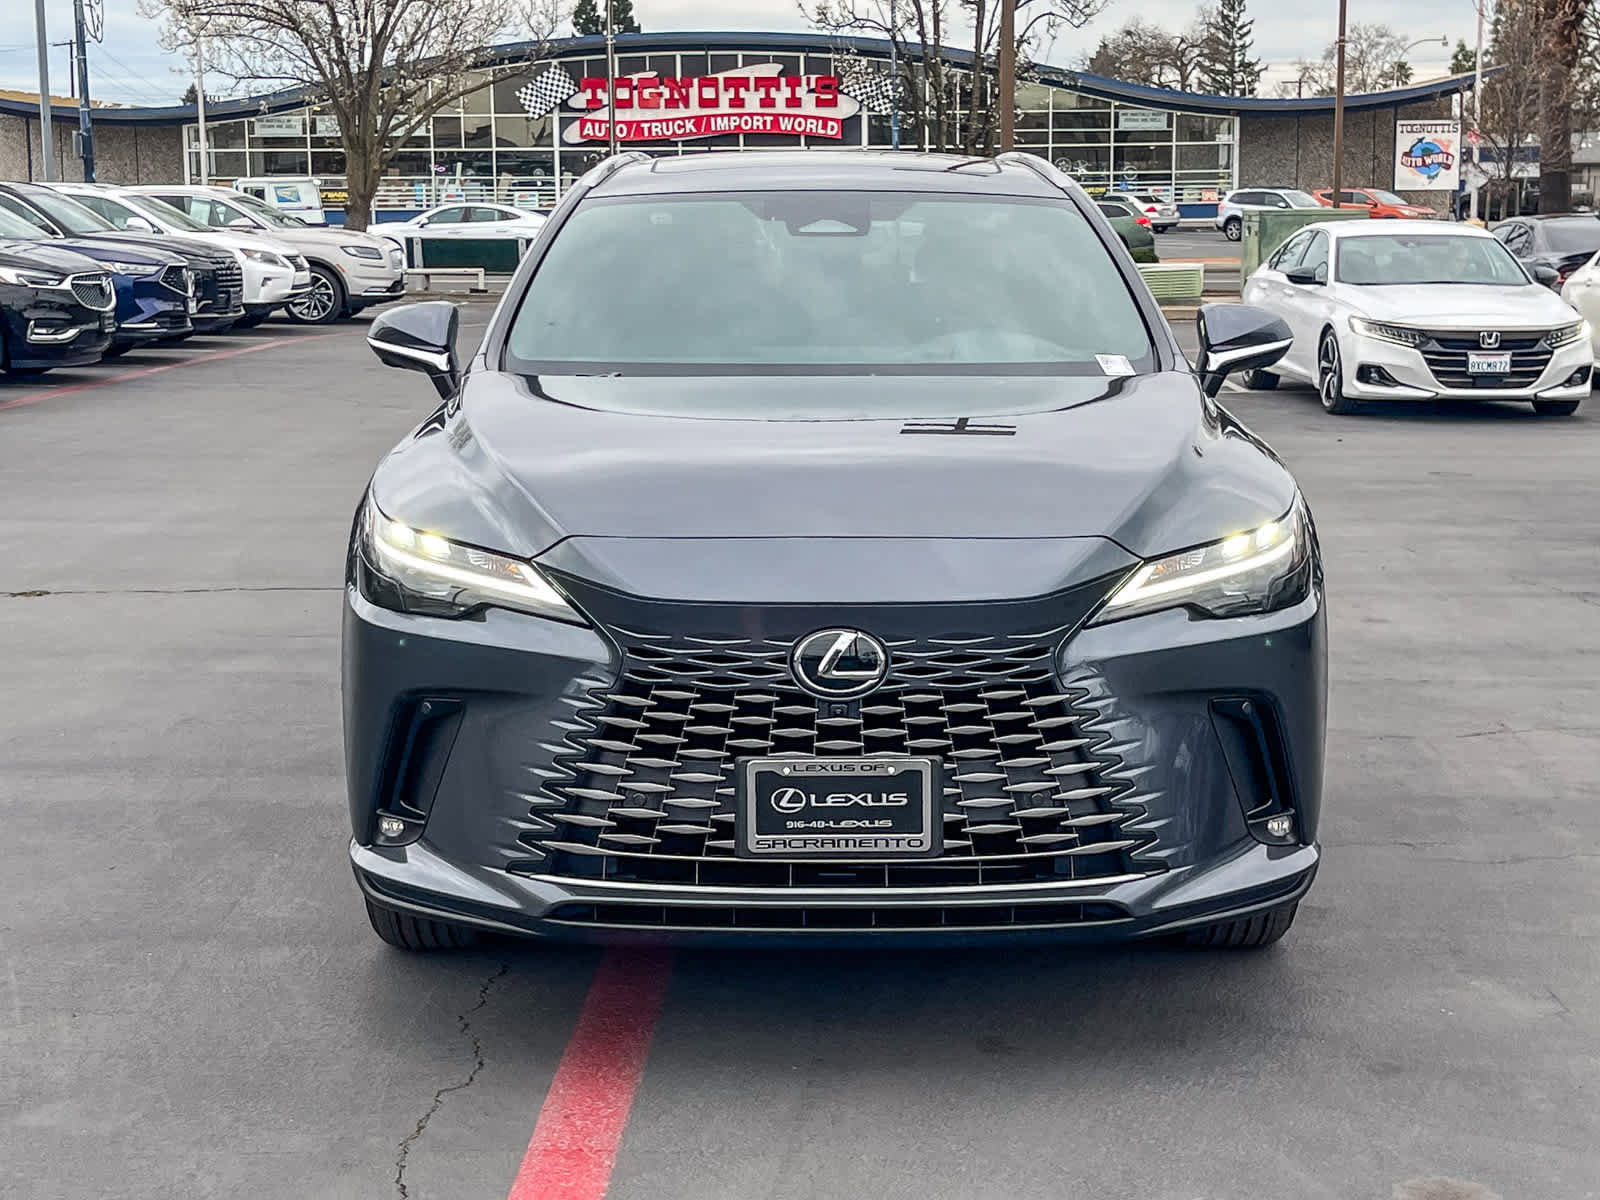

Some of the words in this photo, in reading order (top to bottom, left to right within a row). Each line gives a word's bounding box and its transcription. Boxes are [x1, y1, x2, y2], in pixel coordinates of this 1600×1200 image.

[580, 77, 838, 109] TOGNOTTI'S
[583, 122, 627, 138] AUO
[641, 117, 698, 137] TRUCK
[710, 115, 774, 131] IMPORT
[779, 116, 839, 135] WORLD
[793, 764, 855, 772] LEXUS
[860, 764, 886, 772] OF
[810, 792, 908, 807] LEXUS
[755, 838, 925, 850] SACRAMENTO
